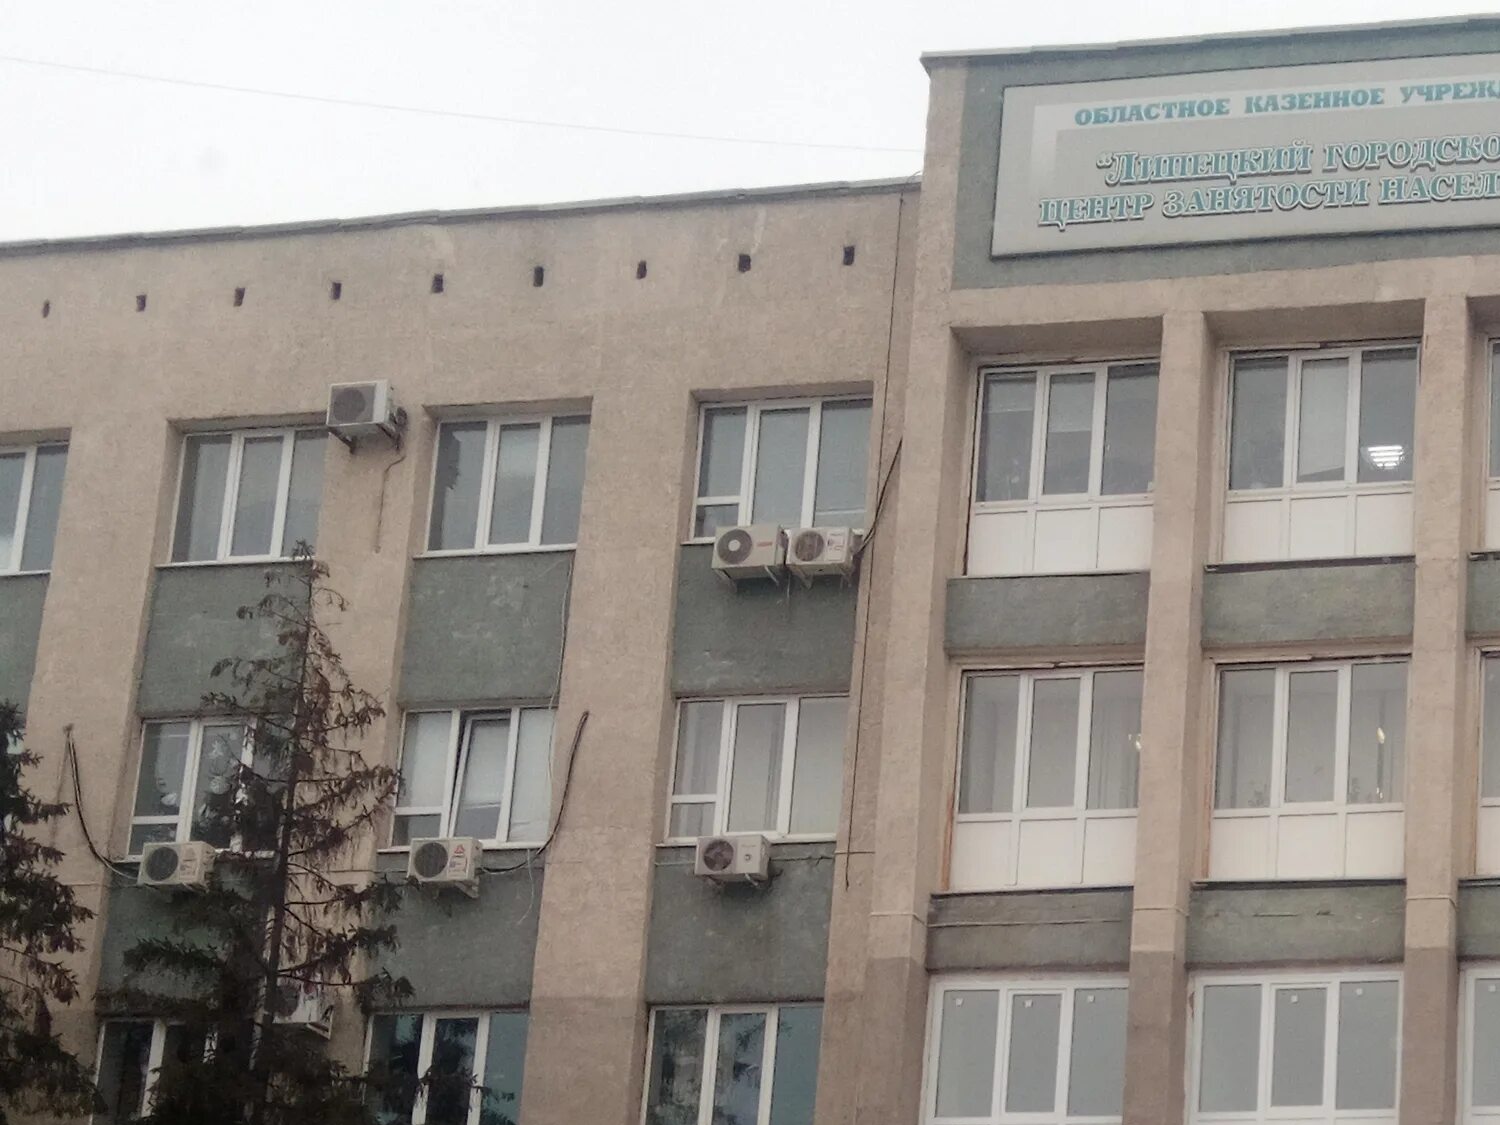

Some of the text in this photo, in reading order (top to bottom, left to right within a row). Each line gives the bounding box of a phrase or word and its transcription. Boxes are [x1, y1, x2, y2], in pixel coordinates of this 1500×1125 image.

[1074, 97, 1232, 126] ОБЛАСТНОЕ
[1244, 88, 1386, 114] КАЗЕННОЕ
[1037, 191, 1154, 232] ЦЕНТР
[1162, 179, 1370, 218] ЗАНЯТОСТИ
